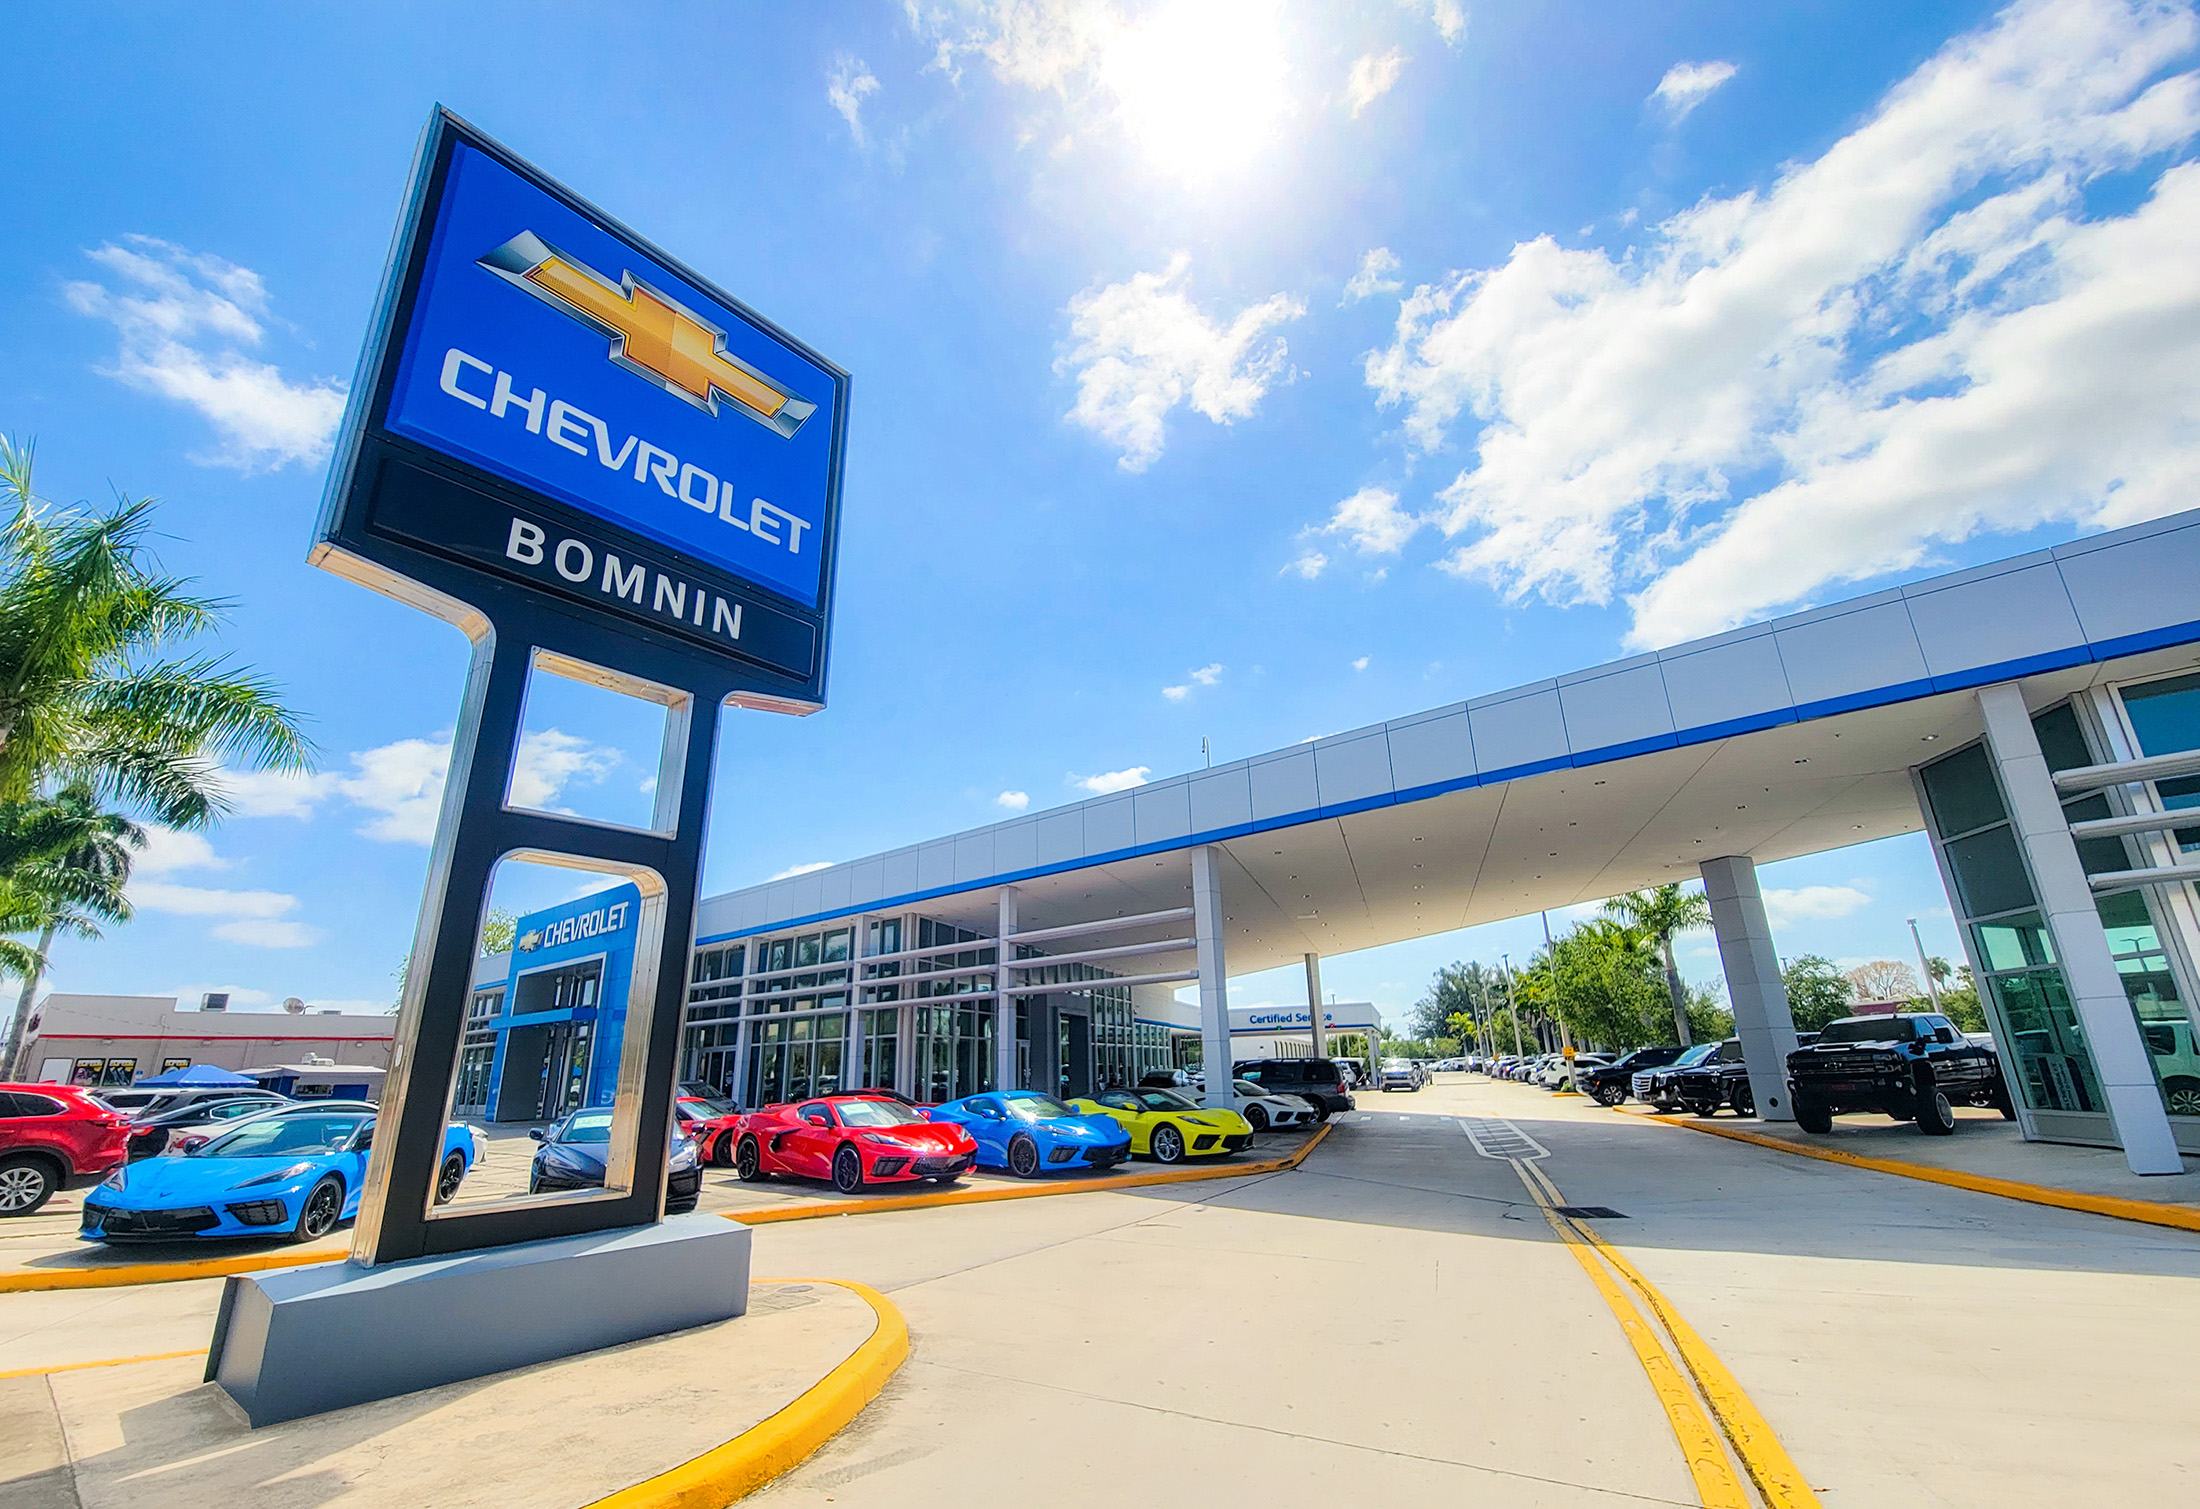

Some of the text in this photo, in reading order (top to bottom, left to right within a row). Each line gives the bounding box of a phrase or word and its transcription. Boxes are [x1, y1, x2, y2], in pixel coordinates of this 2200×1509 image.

[439, 347, 812, 554] CHEVROLET
[506, 517, 743, 640] BOMNIN
[543, 901, 629, 948] CHEVROLET
[1249, 1012, 1333, 1024] Certified Sere
